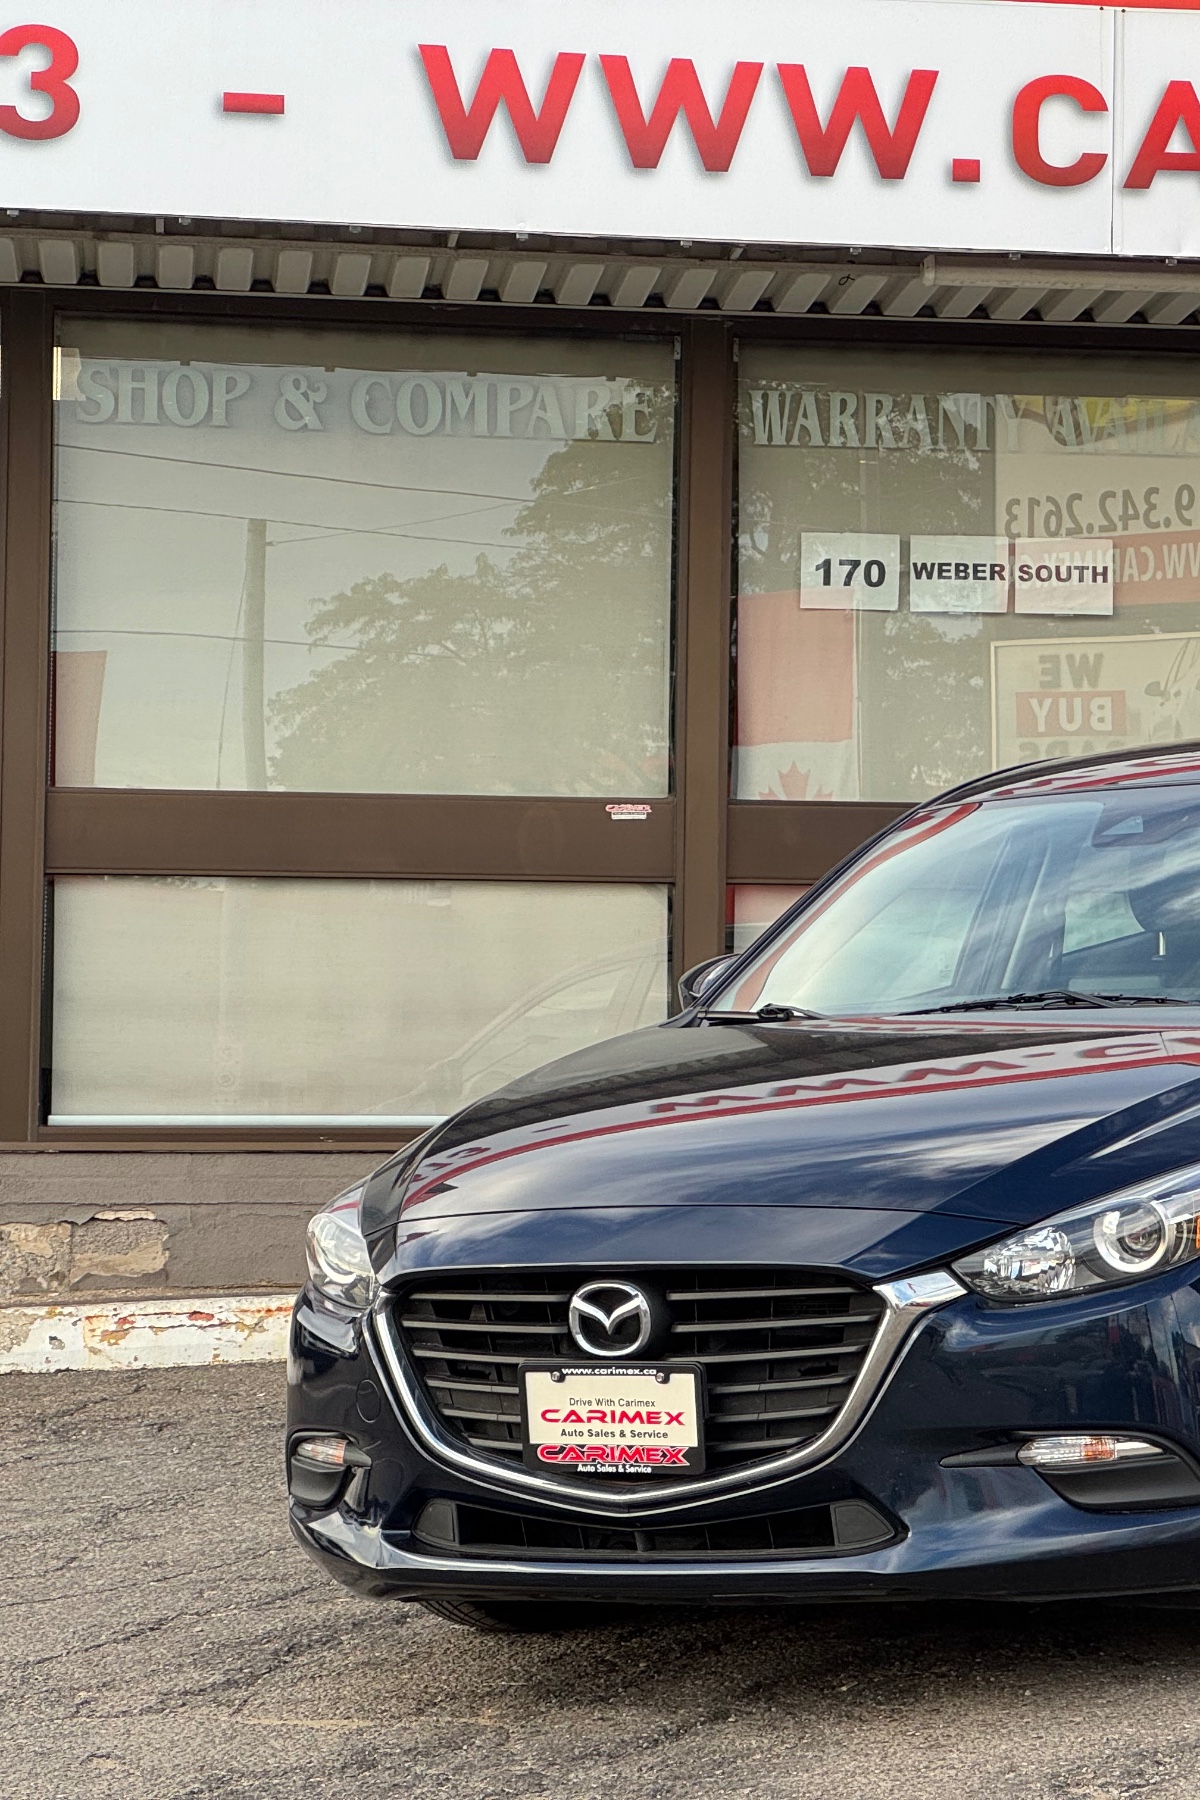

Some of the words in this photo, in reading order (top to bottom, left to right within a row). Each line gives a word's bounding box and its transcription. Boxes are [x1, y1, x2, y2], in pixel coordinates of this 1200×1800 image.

[0, 23, 81, 141] 3
[76, 363, 251, 429] SHOP
[274, 373, 327, 431] &
[351, 372, 657, 444] COMPARE
[749, 389, 1026, 451] WARRANTY
[813, 557, 887, 588] 170
[911, 562, 1007, 582] WEBER
[1017, 563, 1110, 584] SOUTH
[561, 1366, 657, 1376] www.carimex.ca
[569, 1397, 593, 1407] Drive
[594, 1397, 615, 1407] With
[618, 1398, 656, 1408] Carimex
[540, 1408, 686, 1426] CARIMEX
[560, 1428, 584, 1438] Auto
[587, 1429, 616, 1439] Sales
[618, 1429, 627, 1439] &
[630, 1429, 669, 1439] Service
[536, 1443, 690, 1467] CARIMEX
[577, 1463, 596, 1473] Auto
[596, 1463, 617, 1474] Sales
[618, 1464, 625, 1474] &
[625, 1464, 652, 1475] Service
